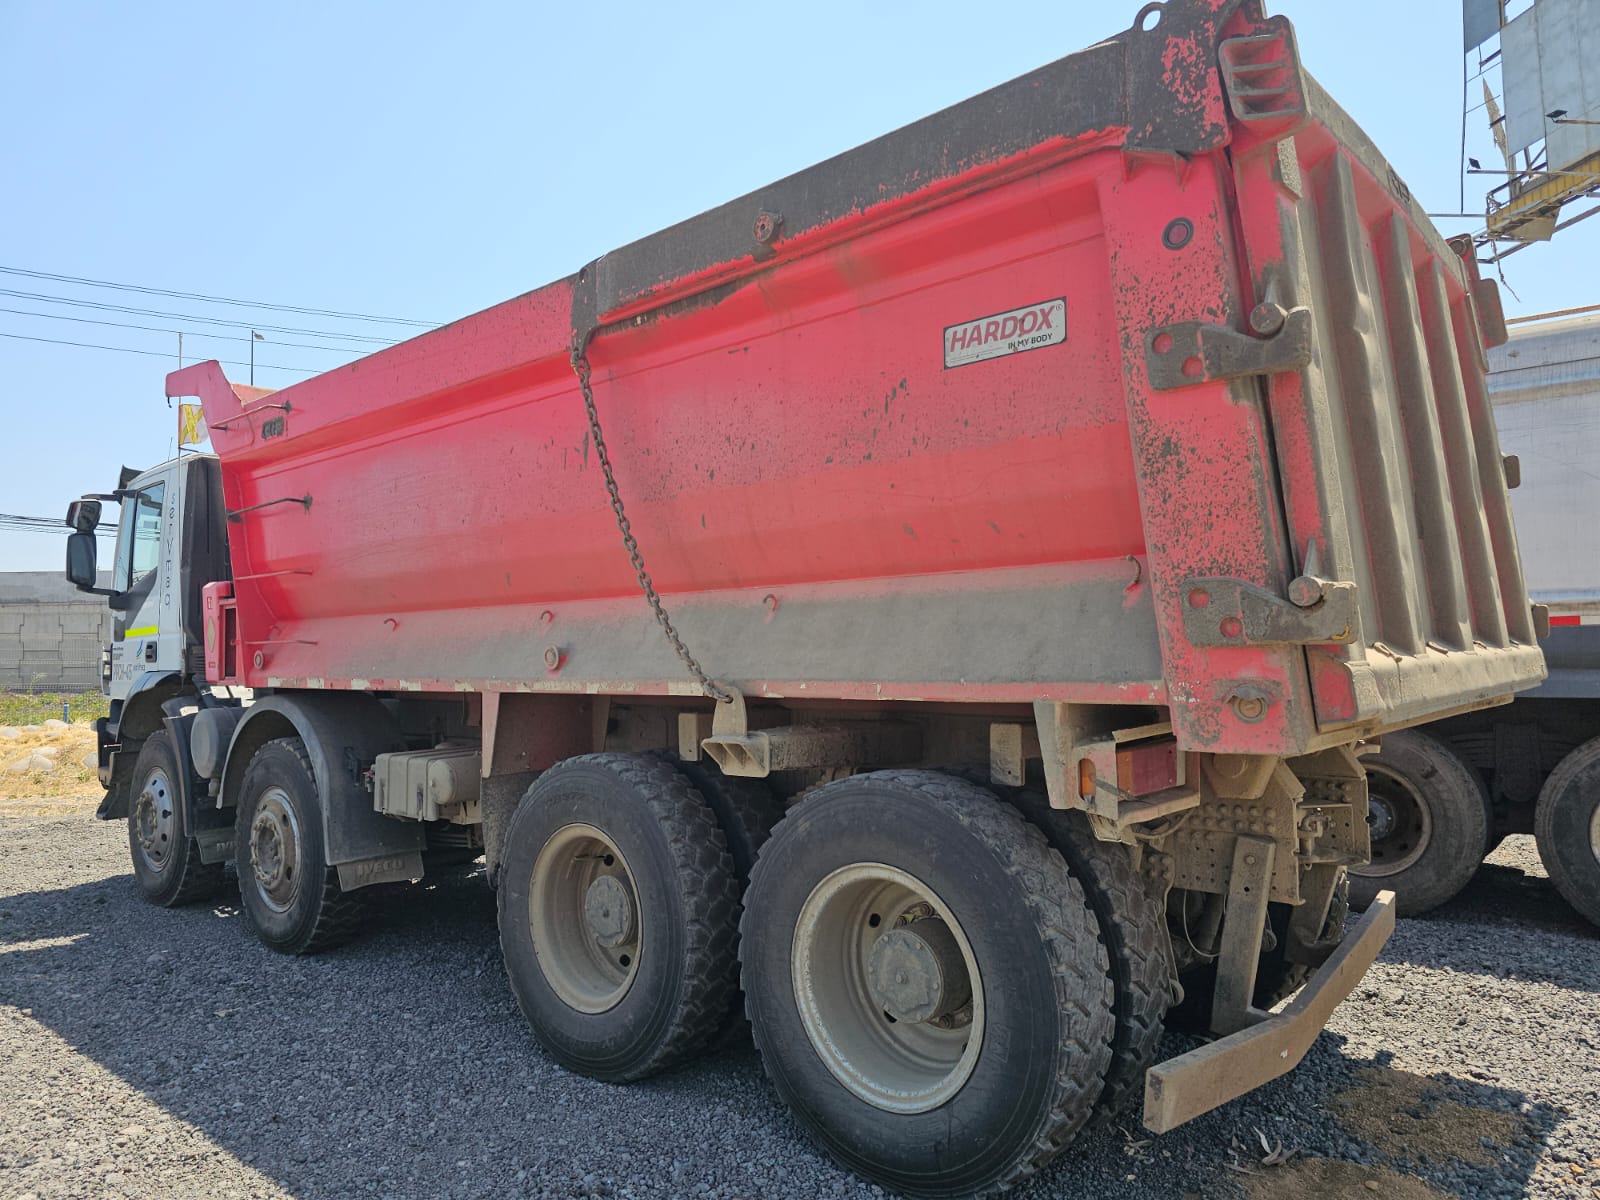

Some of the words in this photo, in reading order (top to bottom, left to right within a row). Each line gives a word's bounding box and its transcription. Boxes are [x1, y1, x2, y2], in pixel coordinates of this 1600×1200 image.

[1007, 340, 1017, 351] IN
[1017, 337, 1030, 348] MY
[1031, 333, 1053, 345] BODY
